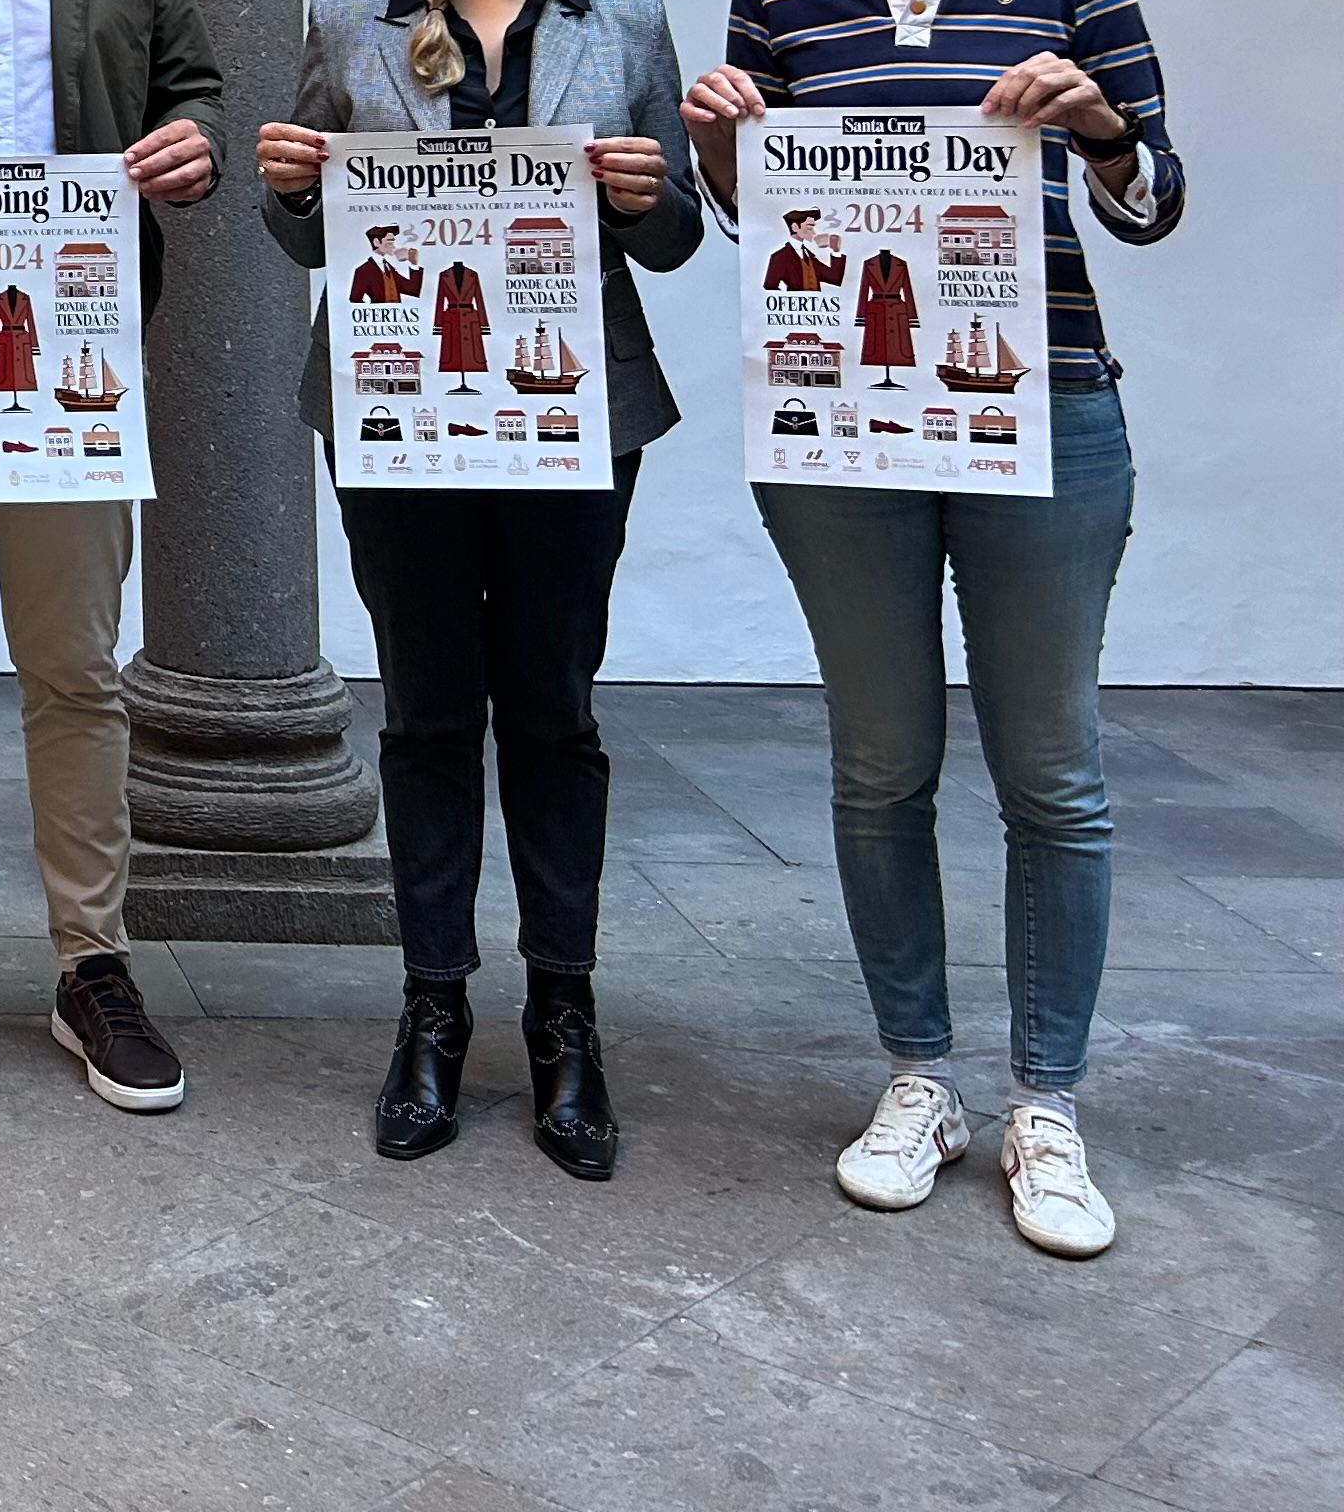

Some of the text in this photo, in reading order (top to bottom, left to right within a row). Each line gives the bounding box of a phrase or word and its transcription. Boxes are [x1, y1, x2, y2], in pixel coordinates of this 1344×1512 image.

[844, 117, 922, 133] Santa Cruz
[419, 136, 488, 152] Santa Cruz
[763, 134, 1017, 183] Shopping Day
[13, 164, 42, 179] Cruz
[346, 152, 573, 199] Shopping Day
[884, 188, 917, 196] SANTA
[920, 188, 945, 196] CRUZ
[948, 188, 961, 196] DE
[965, 188, 979, 196] LA
[60, 180, 118, 222] Day
[348, 205, 381, 213] JUEVES
[456, 203, 485, 211] SANTA
[488, 202, 510, 210] CRUZ
[513, 202, 525, 210] DE
[543, 201, 574, 209] PALMA
[844, 203, 924, 234] 2024
[41, 228, 61, 236] CRUZ
[91, 227, 119, 235] PALMA
[421, 217, 493, 247] 2024
[937, 269, 1018, 283] DONDE CADA
[505, 278, 577, 290] DONDE CADA
[938, 282, 1018, 299] TIENDA ES
[506, 291, 578, 305] TIENDA ES
[765, 295, 841, 313] OFERTAS
[54, 301, 119, 313] DONDE CADA
[55, 313, 119, 327] TIENDA ES
[351, 307, 420, 324] OFERTAS
[766, 313, 840, 327] EXCLUSIVAS
[353, 325, 420, 337] EXCLUSIVAS
